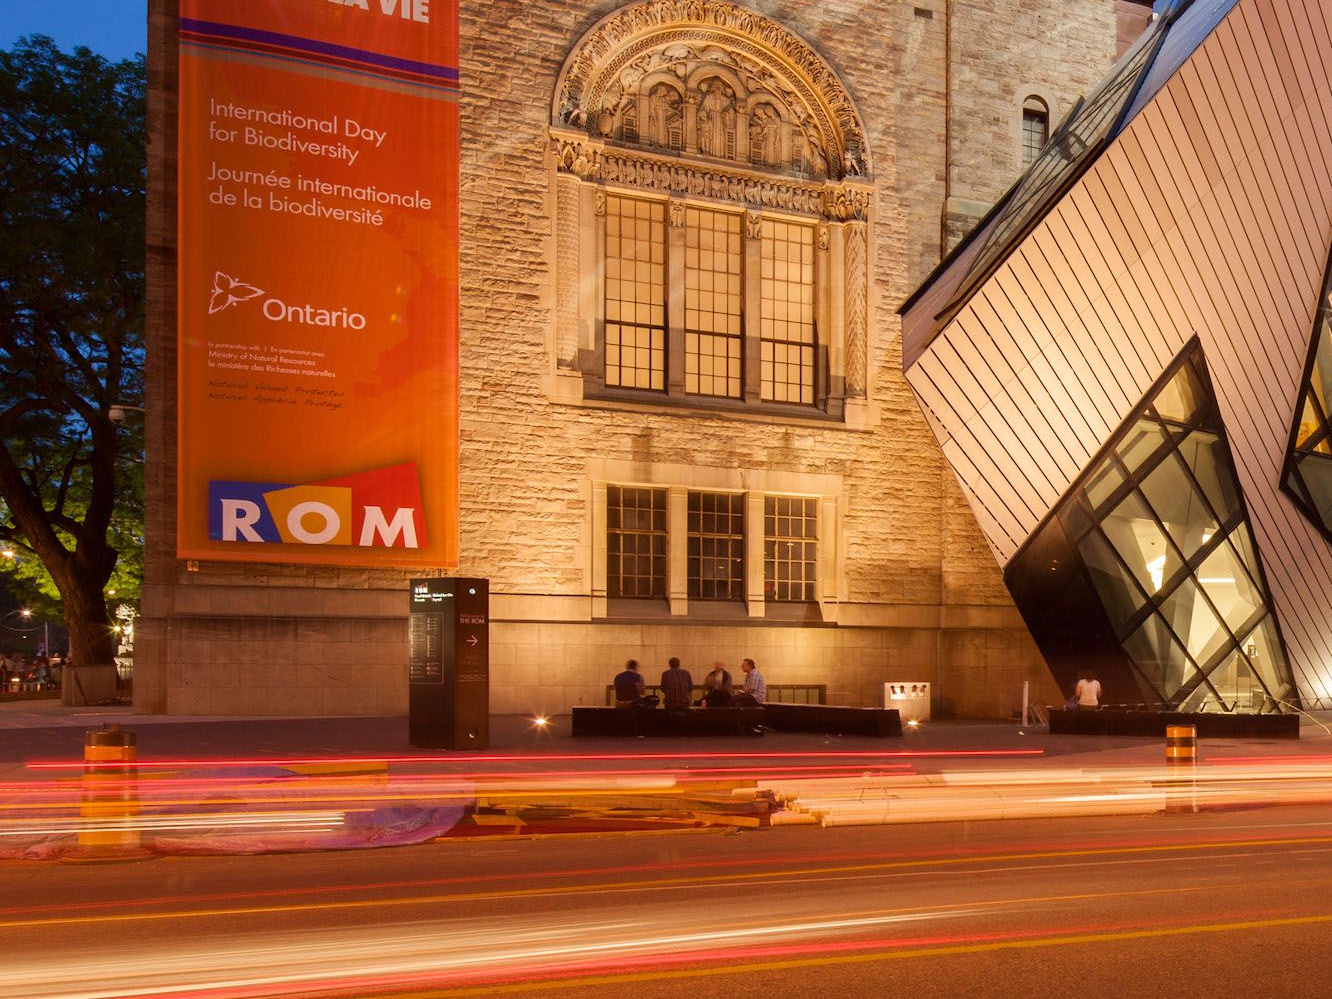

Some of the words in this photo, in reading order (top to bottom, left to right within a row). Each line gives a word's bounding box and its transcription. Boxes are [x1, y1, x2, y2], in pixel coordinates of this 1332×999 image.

[209, 121, 237, 143] for
[245, 127, 359, 166] Biodiversity
[210, 98, 338, 135] International
[345, 120, 387, 147] Day
[207, 162, 291, 188] Journée
[298, 174, 432, 210] internationale
[209, 186, 237, 206] de
[244, 188, 262, 209] la
[270, 196, 383, 226] biodiversité
[263, 298, 366, 330] Ontario
[208, 350, 239, 361] Ministry
[249, 354, 278, 363] Natural
[279, 356, 316, 366] Resources
[266, 364, 300, 375] Richesses
[301, 369, 336, 378] naturelles
[220, 498, 418, 548] ROM
